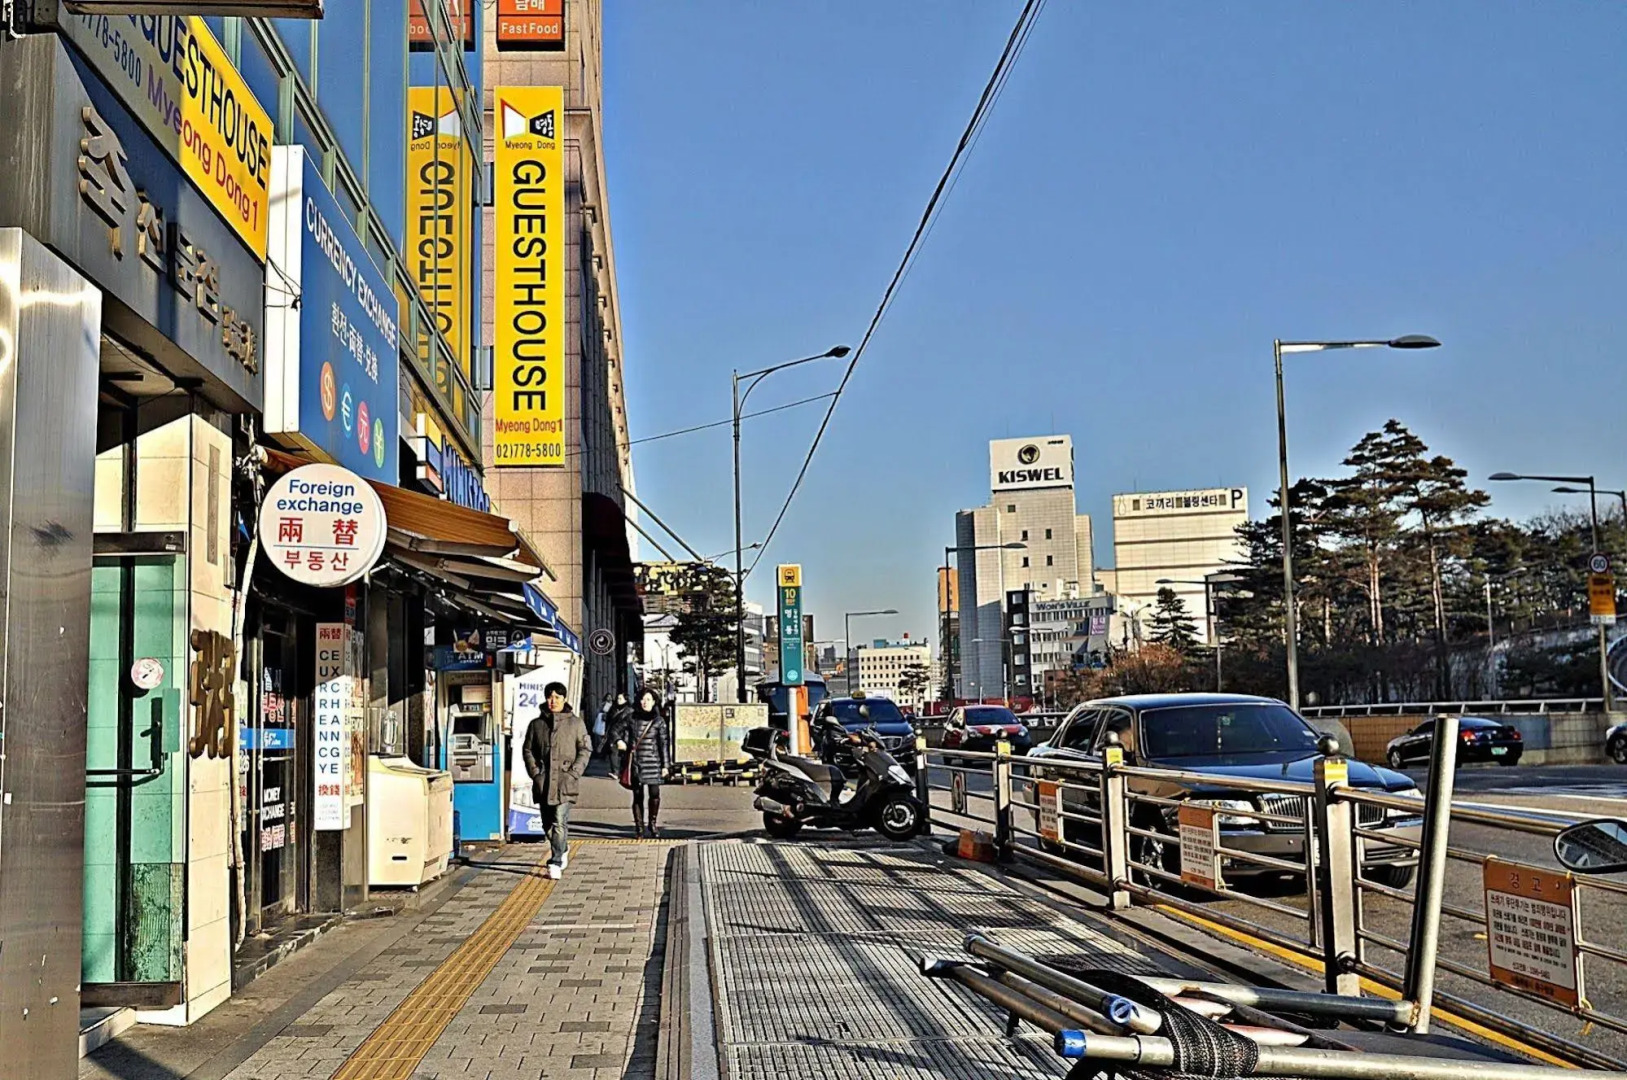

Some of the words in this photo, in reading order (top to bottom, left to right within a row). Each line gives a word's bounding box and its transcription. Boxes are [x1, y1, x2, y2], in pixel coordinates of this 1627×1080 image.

[501, 22, 527, 34] Fast
[529, 22, 559, 34] Food
[148, 65, 211, 176] Myeong
[505, 141, 532, 150] Myeong
[537, 141, 555, 150] Dong
[306, 197, 357, 294] CURRENCY
[357, 273, 396, 351] EXCHANGE
[512, 159, 547, 411] GUESTHOUSE
[495, 418, 531, 434] Myeong
[496, 443, 561, 459] 02)778-5800
[999, 468, 1064, 483] KISWEL
[289, 479, 355, 498] Foreign
[277, 497, 364, 515] exchange
[1231, 489, 1243, 509] P
[284, 551, 349, 572] 부동산
[785, 588, 796, 599] 10
[519, 692, 538, 707] 24
